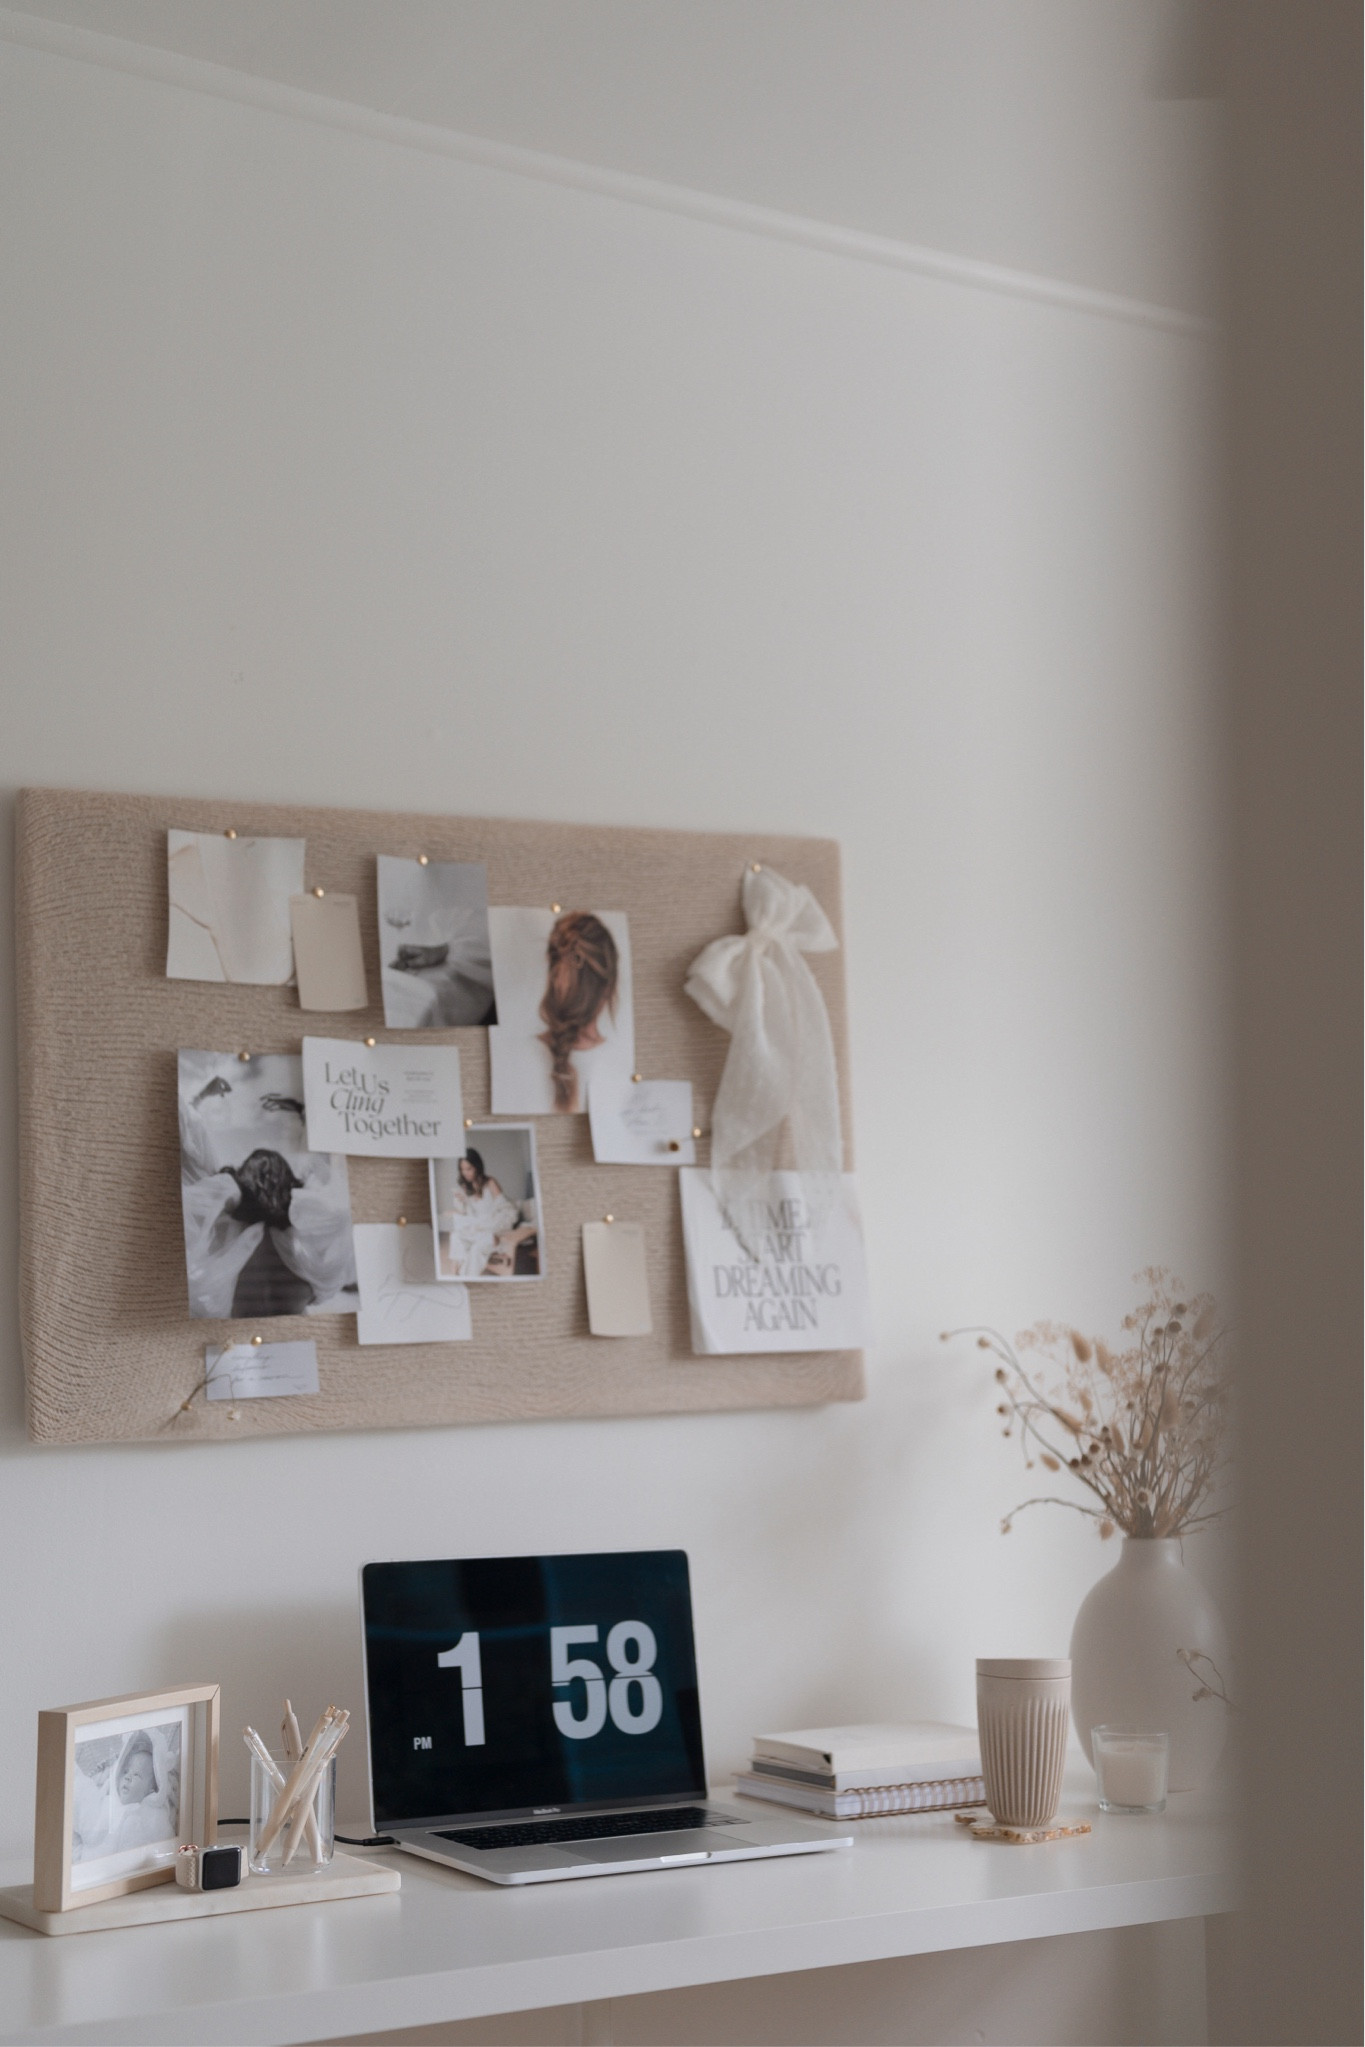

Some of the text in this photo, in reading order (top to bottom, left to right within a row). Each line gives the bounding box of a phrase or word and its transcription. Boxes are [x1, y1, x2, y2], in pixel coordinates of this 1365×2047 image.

[324, 1061, 390, 1095] Let Us
[330, 1088, 386, 1118] Cling
[338, 1110, 442, 1141] Together
[712, 1263, 843, 1299] DREAMING
[743, 1298, 819, 1332] AGAIN
[437, 1619, 664, 1747] 1 58
[413, 1736, 433, 1751] PM
